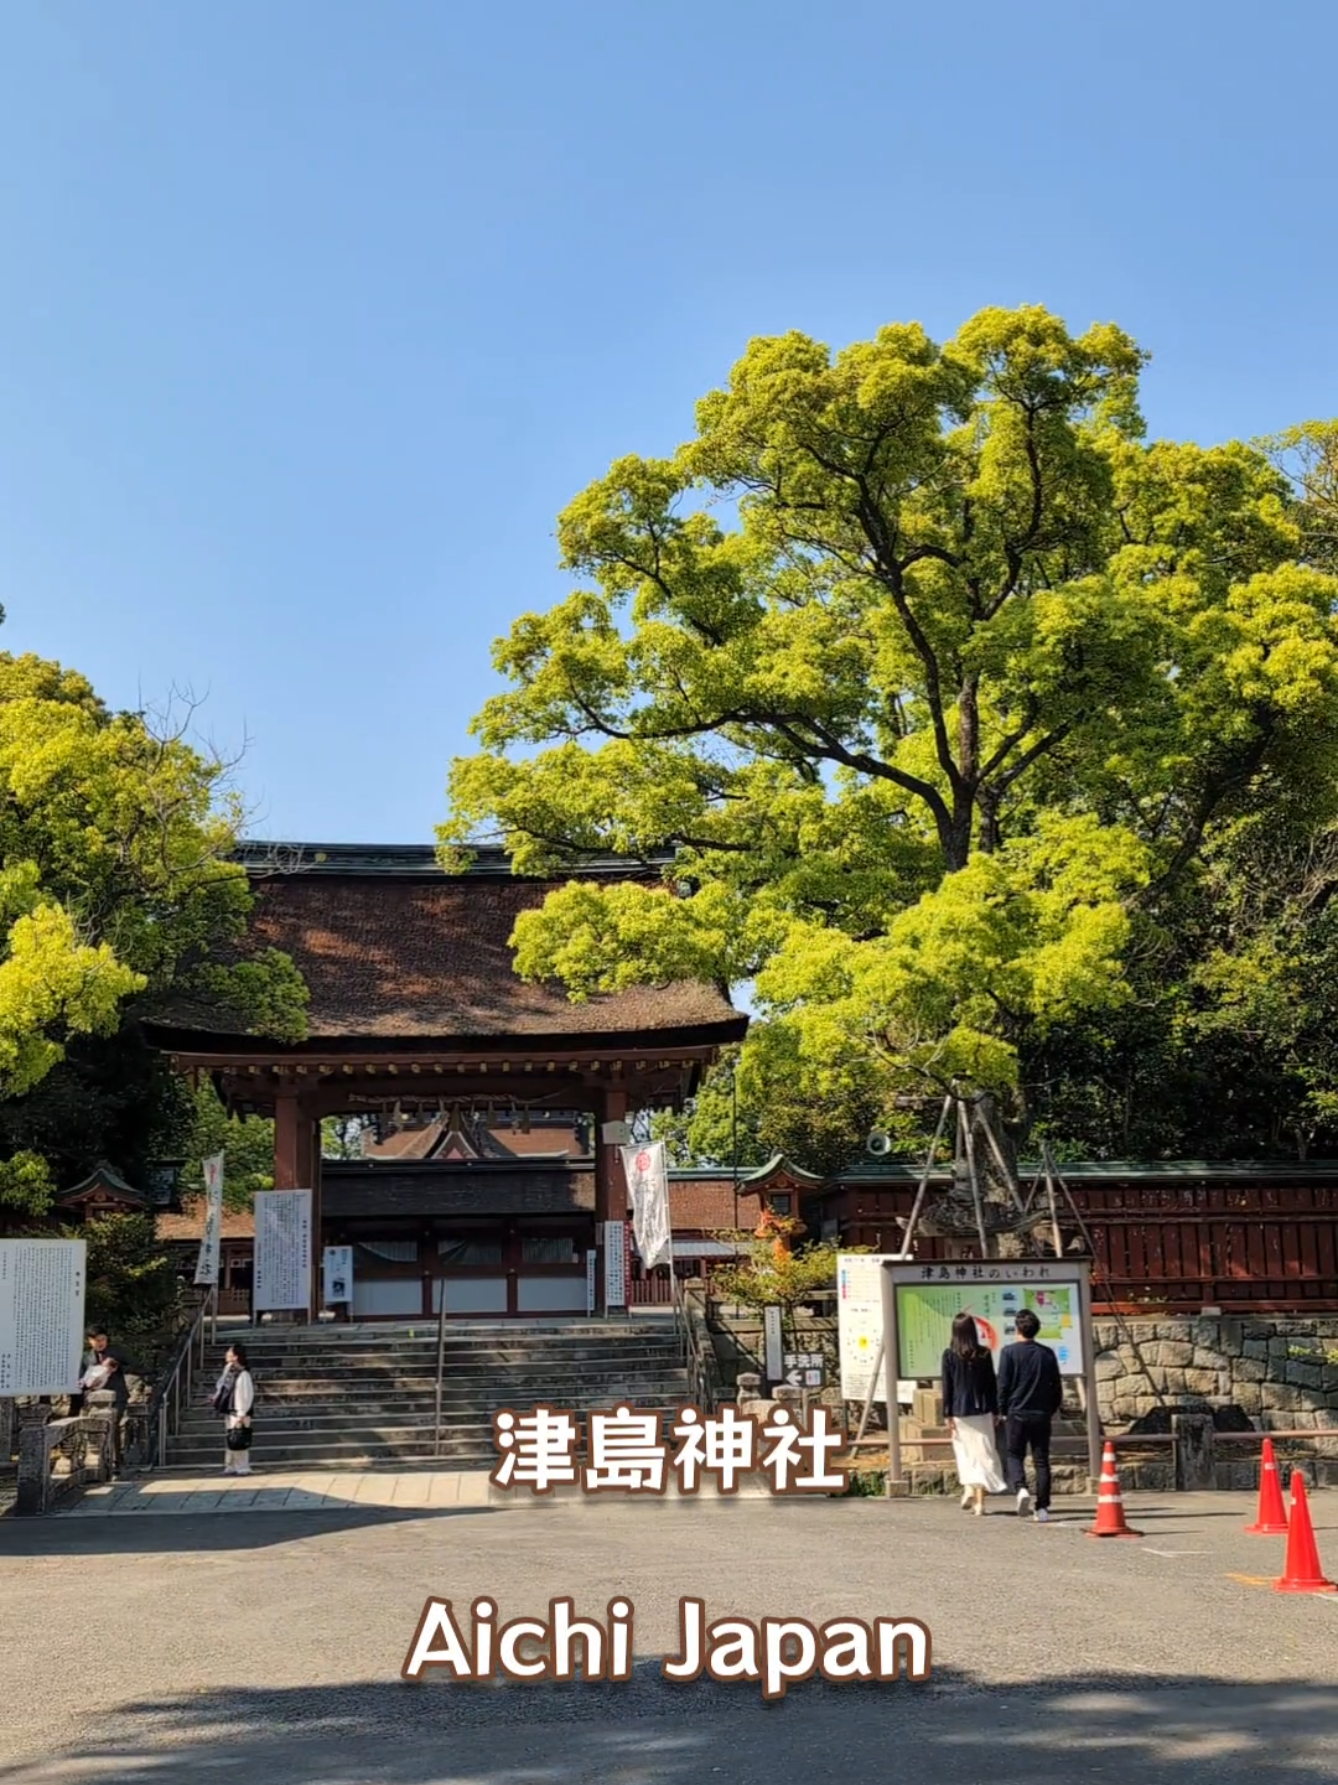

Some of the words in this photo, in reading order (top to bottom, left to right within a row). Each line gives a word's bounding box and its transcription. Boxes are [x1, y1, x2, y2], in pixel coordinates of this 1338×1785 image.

[921, 1266, 1050, 1279] 津島神社のいわれ
[784, 1354, 824, 1368] 手洗所
